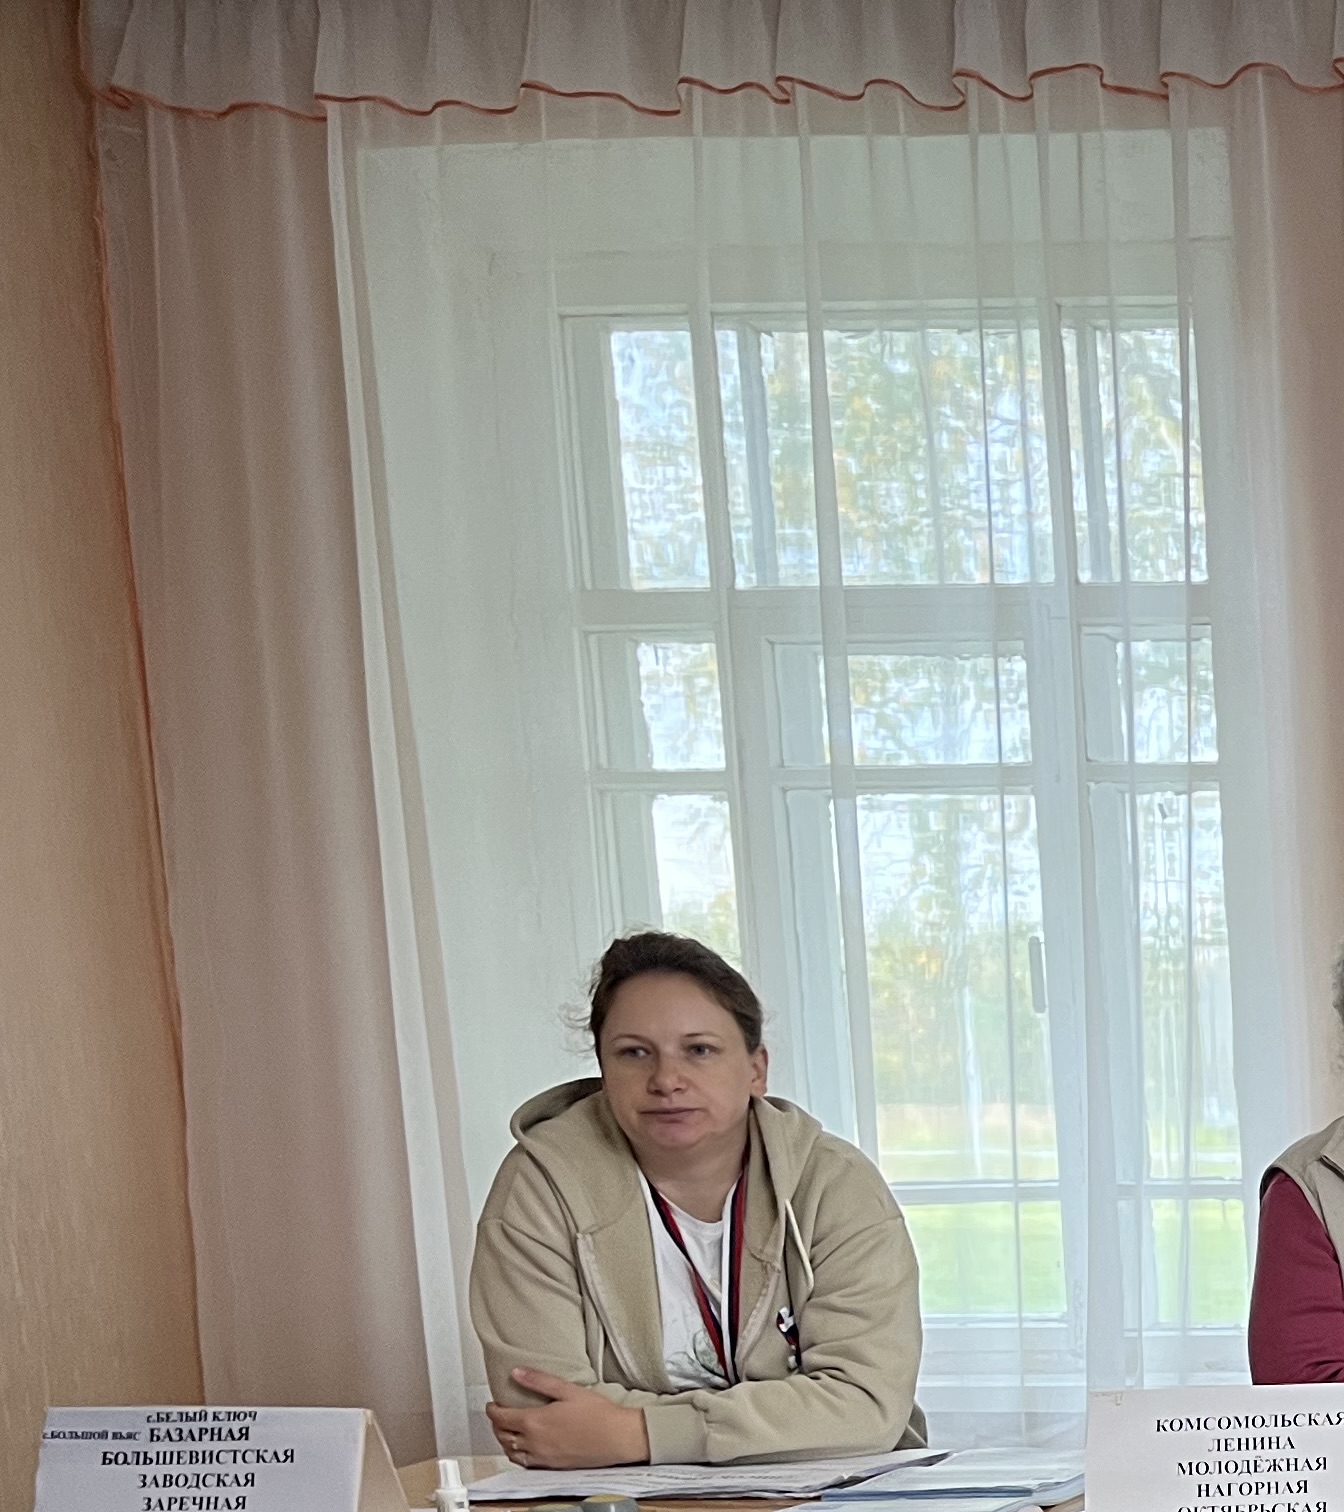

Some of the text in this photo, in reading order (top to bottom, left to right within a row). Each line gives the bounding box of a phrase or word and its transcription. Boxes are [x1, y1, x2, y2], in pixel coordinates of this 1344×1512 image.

[211, 1409, 258, 1423] КЛЮЧ
[149, 1426, 250, 1443] БАЗАРНАЯ
[1207, 1435, 1296, 1452] ЛЕНИНА
[100, 1448, 295, 1466] БОЛЬШЕВИСТСКАЯ
[1176, 1455, 1328, 1477] МОЛОДЁЖНАЯ
[138, 1472, 256, 1490] ЗАВОДСКАЯ
[1197, 1479, 1308, 1498] НАГОРНАЯ
[143, 1495, 247, 1512] ЗАРЕЧНАЯ
